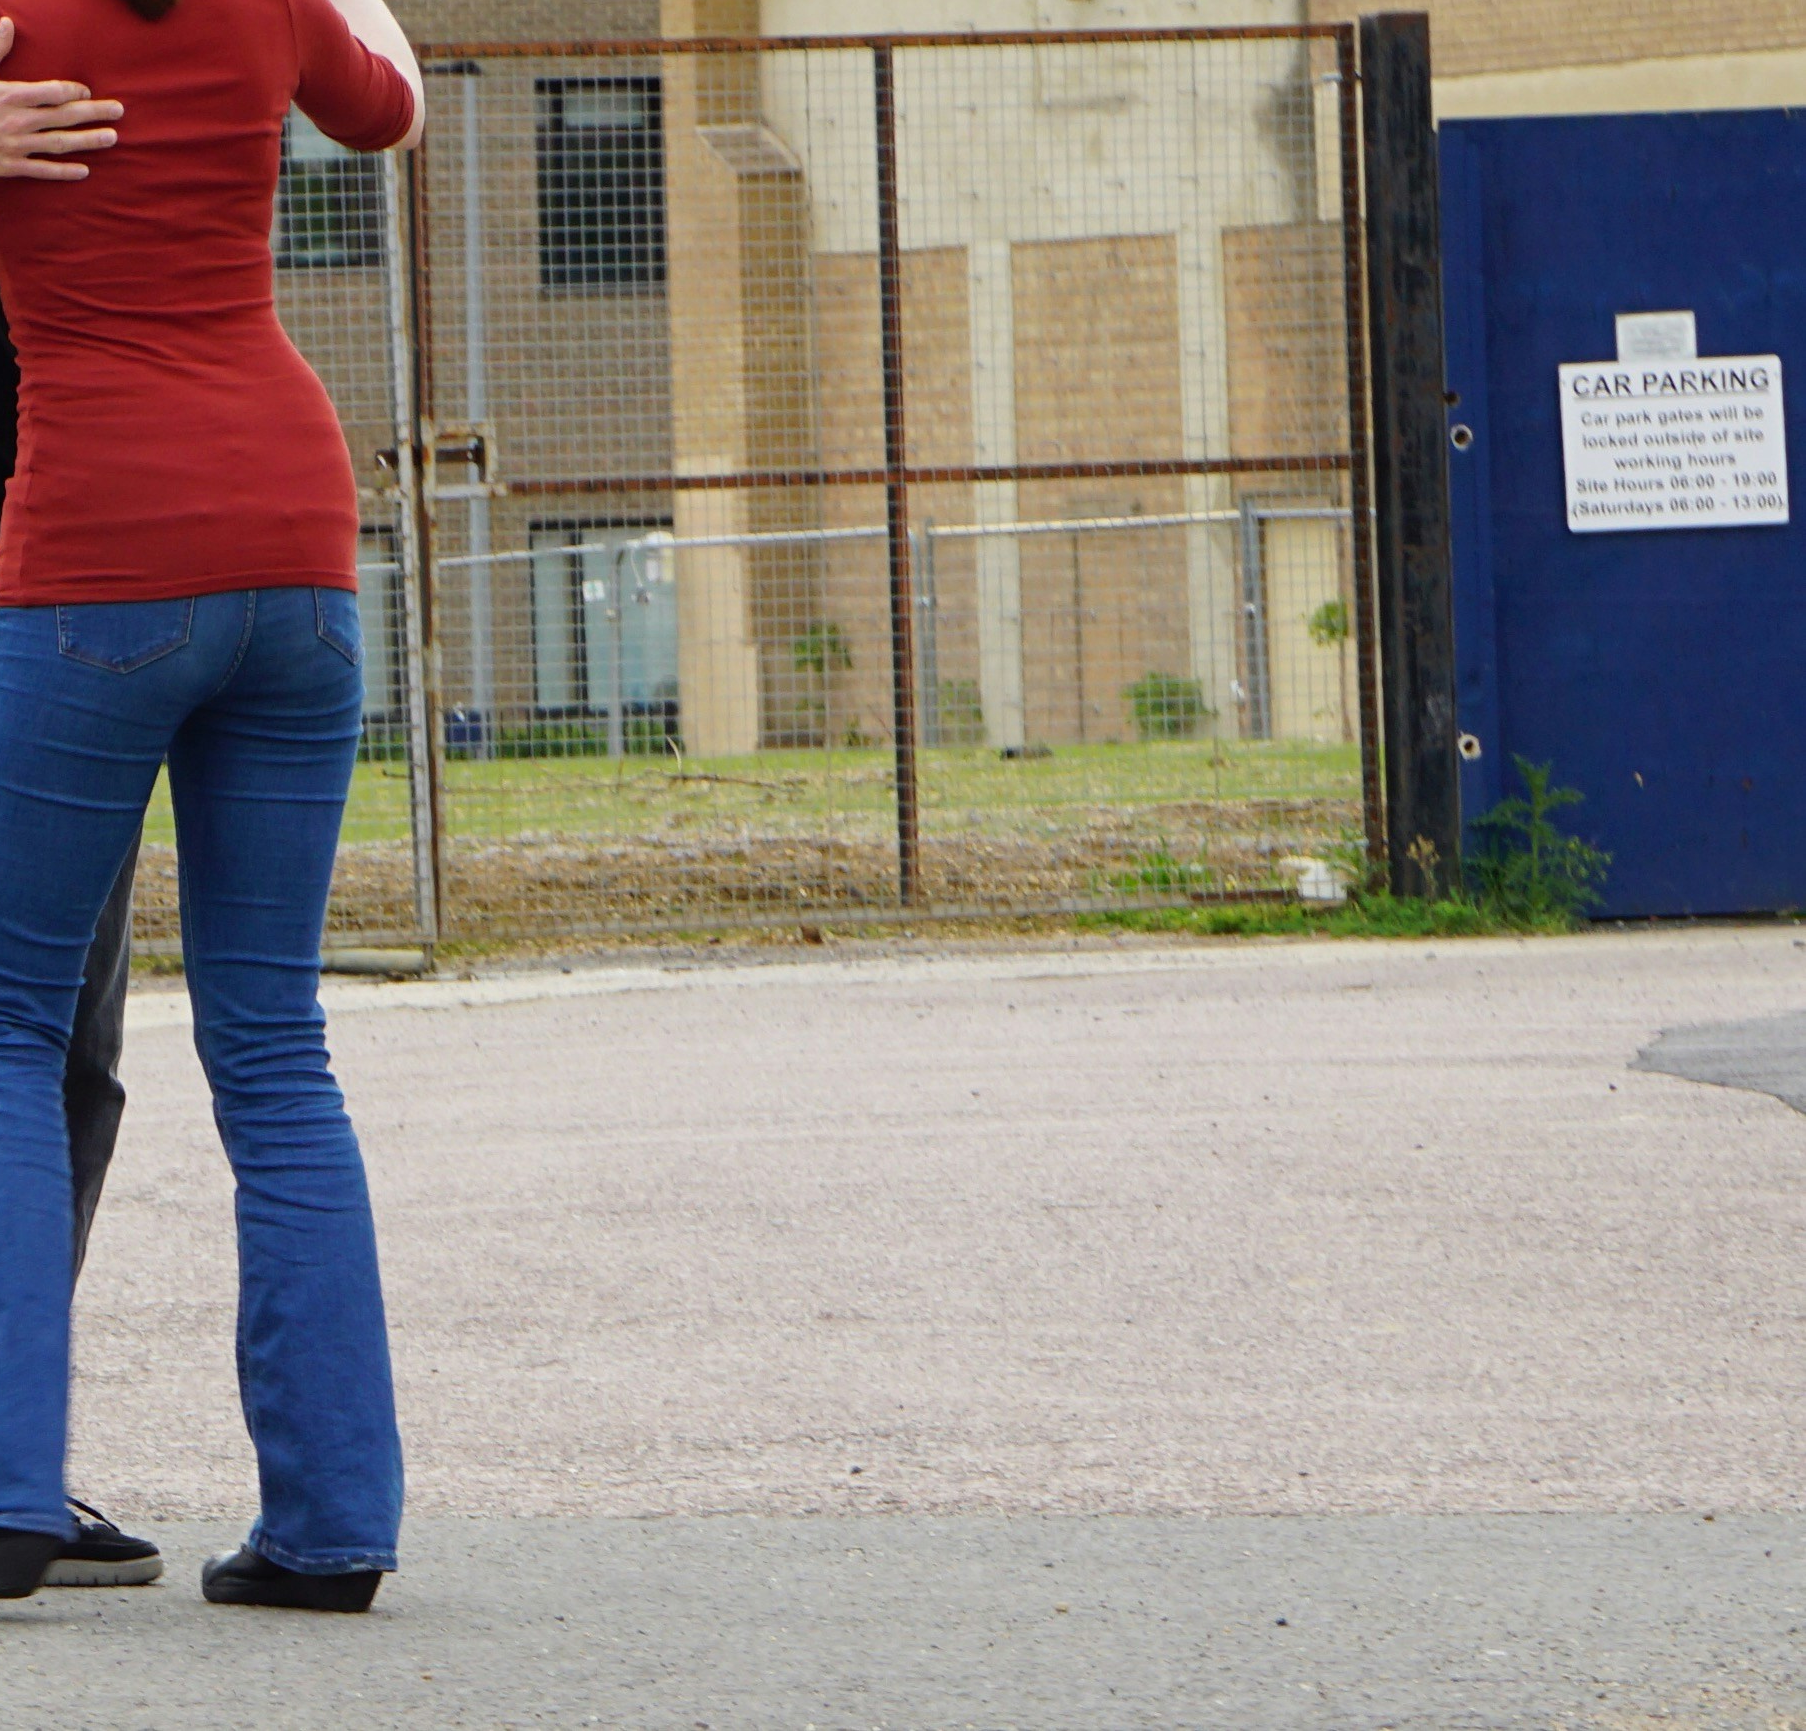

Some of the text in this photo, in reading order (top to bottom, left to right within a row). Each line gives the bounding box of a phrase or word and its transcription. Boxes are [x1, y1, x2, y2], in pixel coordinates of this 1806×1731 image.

[1572, 368, 1770, 397] CAR PARKING
[1580, 405, 1764, 428] Car park gates will be
[1582, 428, 1764, 449] locked outside of site
[1614, 452, 1737, 471] working hours
[1576, 477, 1608, 494] Site
[1614, 475, 1664, 490] Hours
